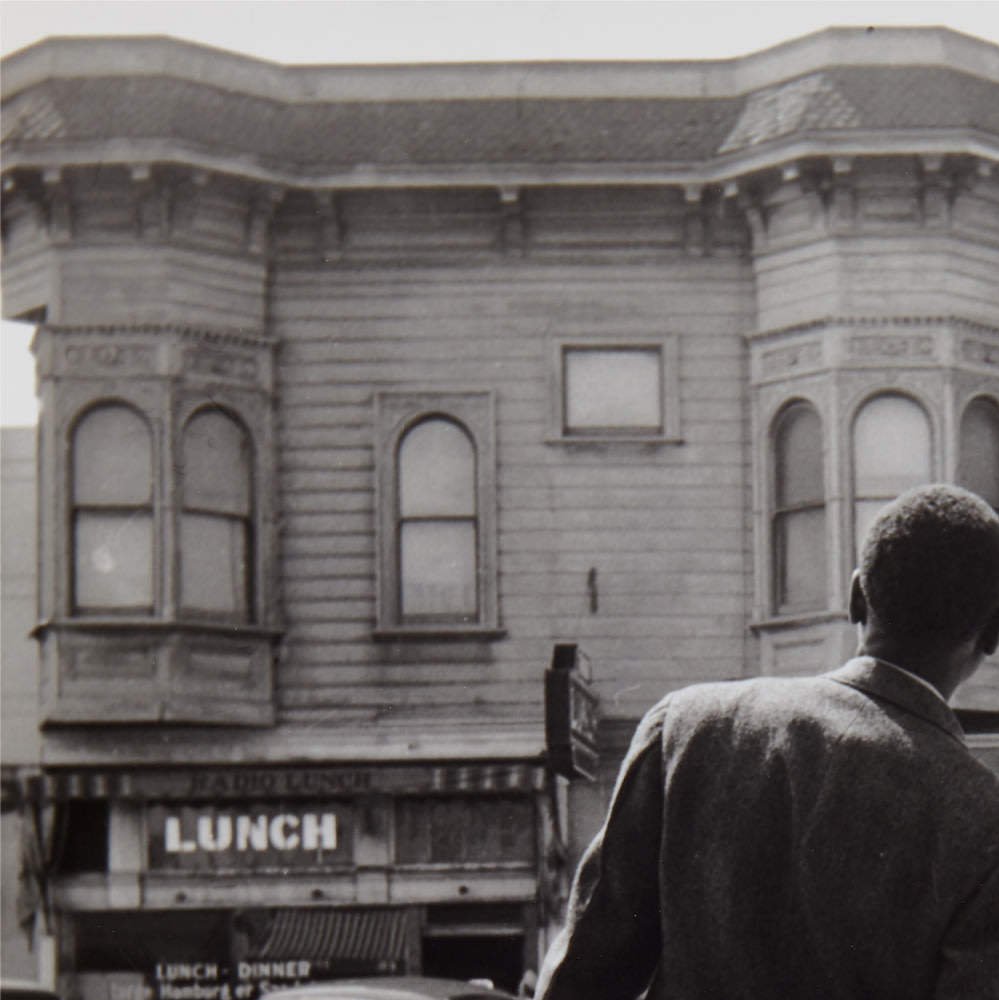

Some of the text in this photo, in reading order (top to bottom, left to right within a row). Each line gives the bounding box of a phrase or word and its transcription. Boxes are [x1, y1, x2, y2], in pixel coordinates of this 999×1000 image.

[286, 771, 372, 792] LUNCH
[164, 812, 337, 853] LUNCH
[156, 963, 218, 981] LUNCH
[237, 961, 311, 979] DINNER
